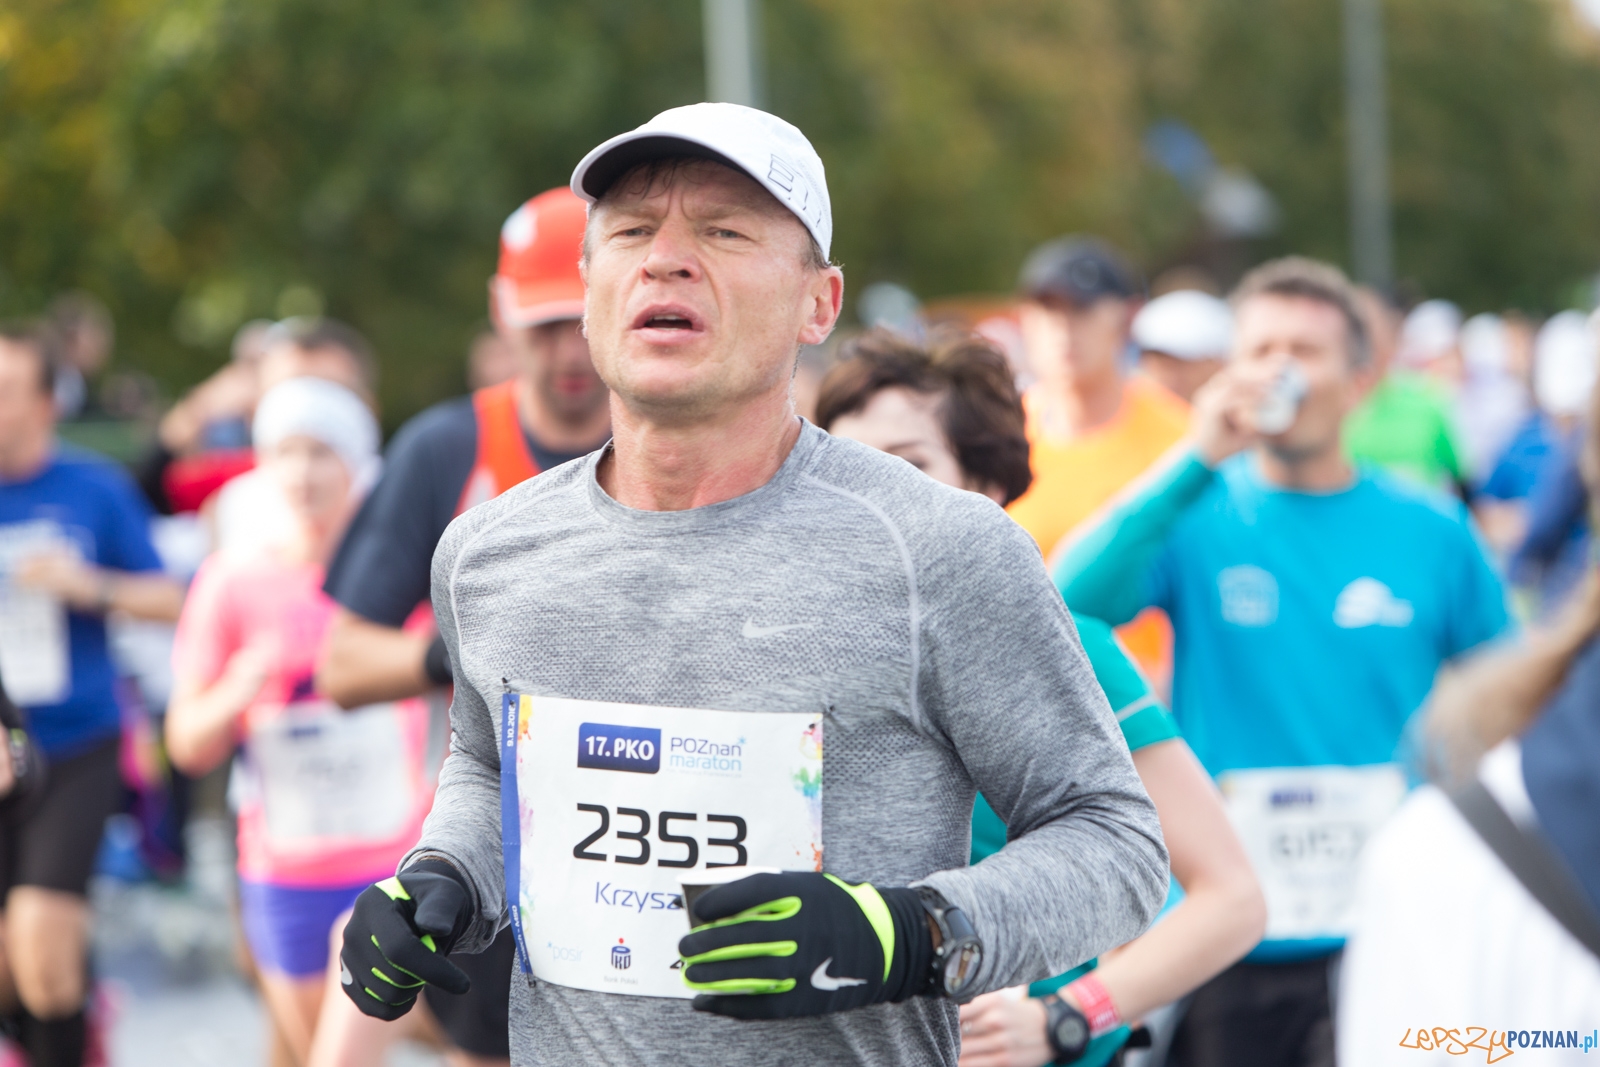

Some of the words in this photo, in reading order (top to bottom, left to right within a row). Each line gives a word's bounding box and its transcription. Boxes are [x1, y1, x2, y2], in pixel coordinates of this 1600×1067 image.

[585, 735, 611, 757] 17.
[613, 738, 655, 761] PKO
[669, 754, 742, 771] maraton
[573, 802, 747, 869] 2353
[512, 905, 520, 927] M50
[604, 975, 618, 983] Bank
[620, 976, 639, 985] Polski
